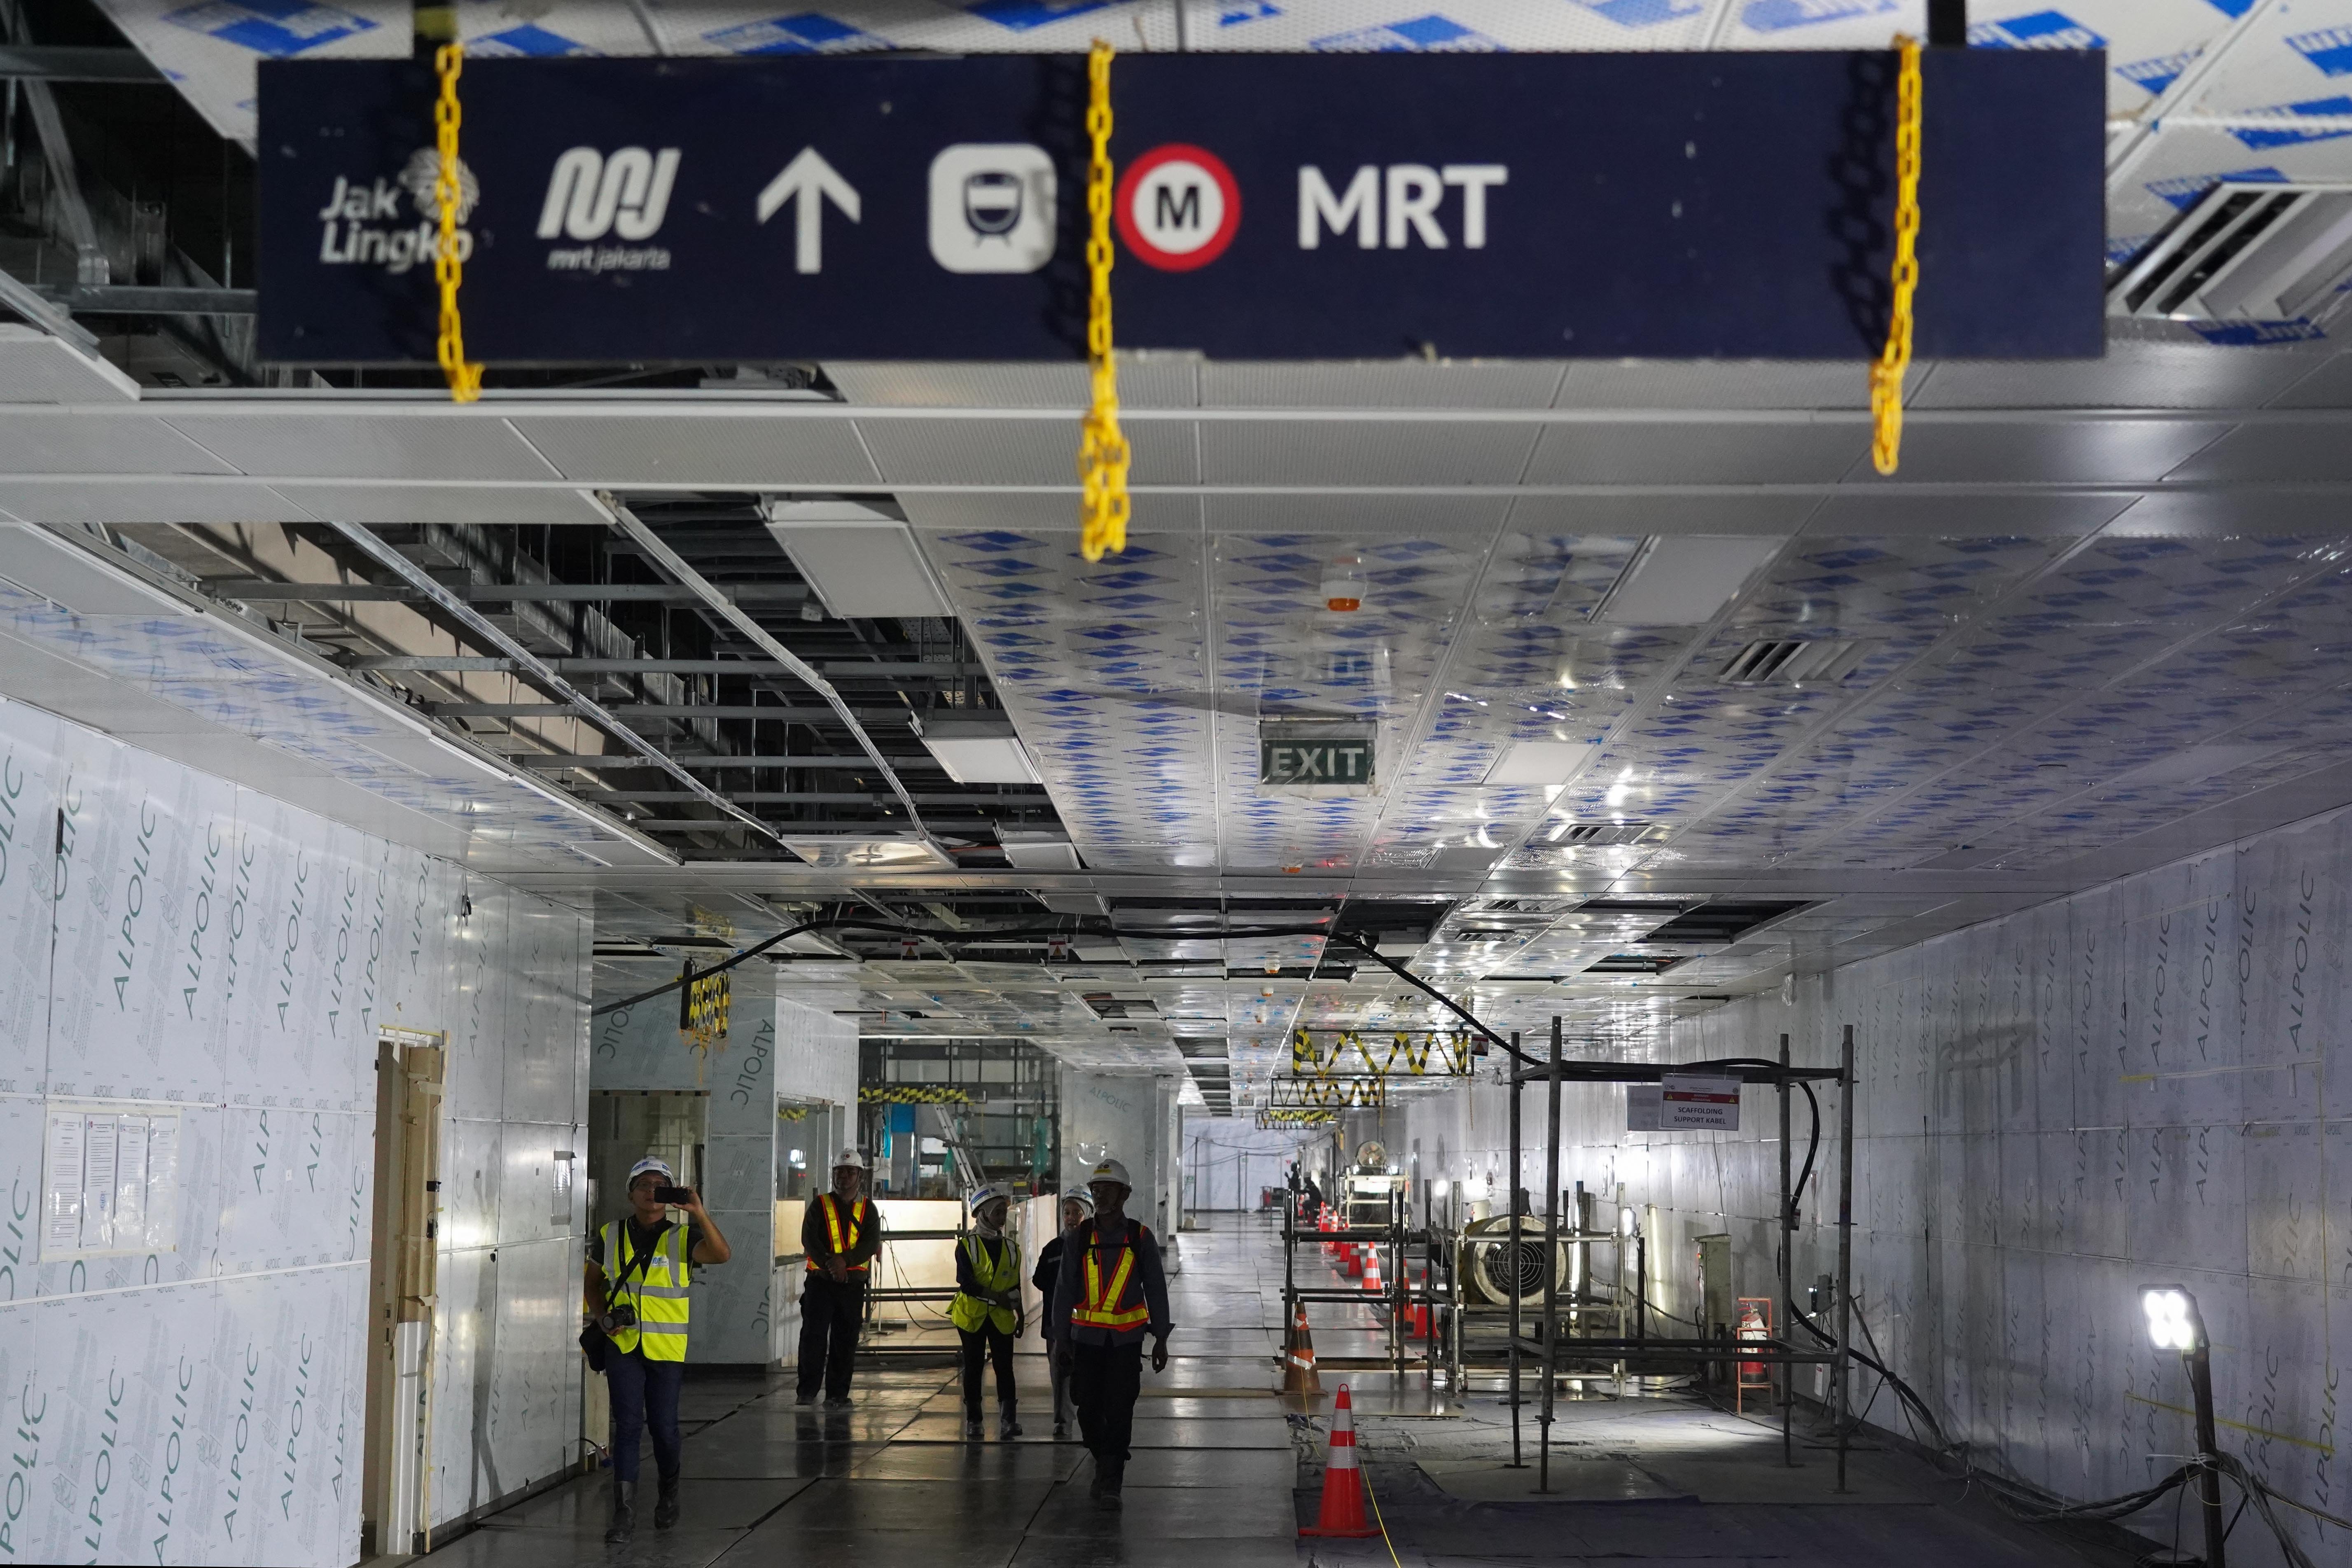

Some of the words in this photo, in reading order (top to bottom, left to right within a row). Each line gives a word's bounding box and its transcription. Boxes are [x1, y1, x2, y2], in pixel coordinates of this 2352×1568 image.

[319, 175, 401, 221] Jak
[320, 221, 474, 273] Lingko
[1156, 182, 1201, 230] M
[1297, 164, 1508, 250] MRT
[1272, 748, 1364, 776] EXIT
[114, 799, 155, 1012] ALPOLIC
[184, 822, 220, 1021] ALPOLIC
[278, 850, 308, 1033] ALPOLIC
[329, 867, 356, 1040] ALPOLIC
[2197, 895, 2218, 1062] ALPOLIC
[2289, 869, 2313, 1054] ALPOLIC
[470, 912, 490, 1058] ALPOLIC
[2042, 933, 2056, 1073] ALPOLIC
[2079, 928, 2095, 1074] ALPOLIC
[2151, 908, 2170, 1067] ALPOLIC
[731, 1019, 775, 1105] ALPOLIC
[1090, 1087, 1132, 1112] ALPOLIC
[154, 1355, 192, 1566] ALPOLIC
[224, 1343, 258, 1543] ALPOLIC
[281, 1333, 312, 1522] ALPOLIC
